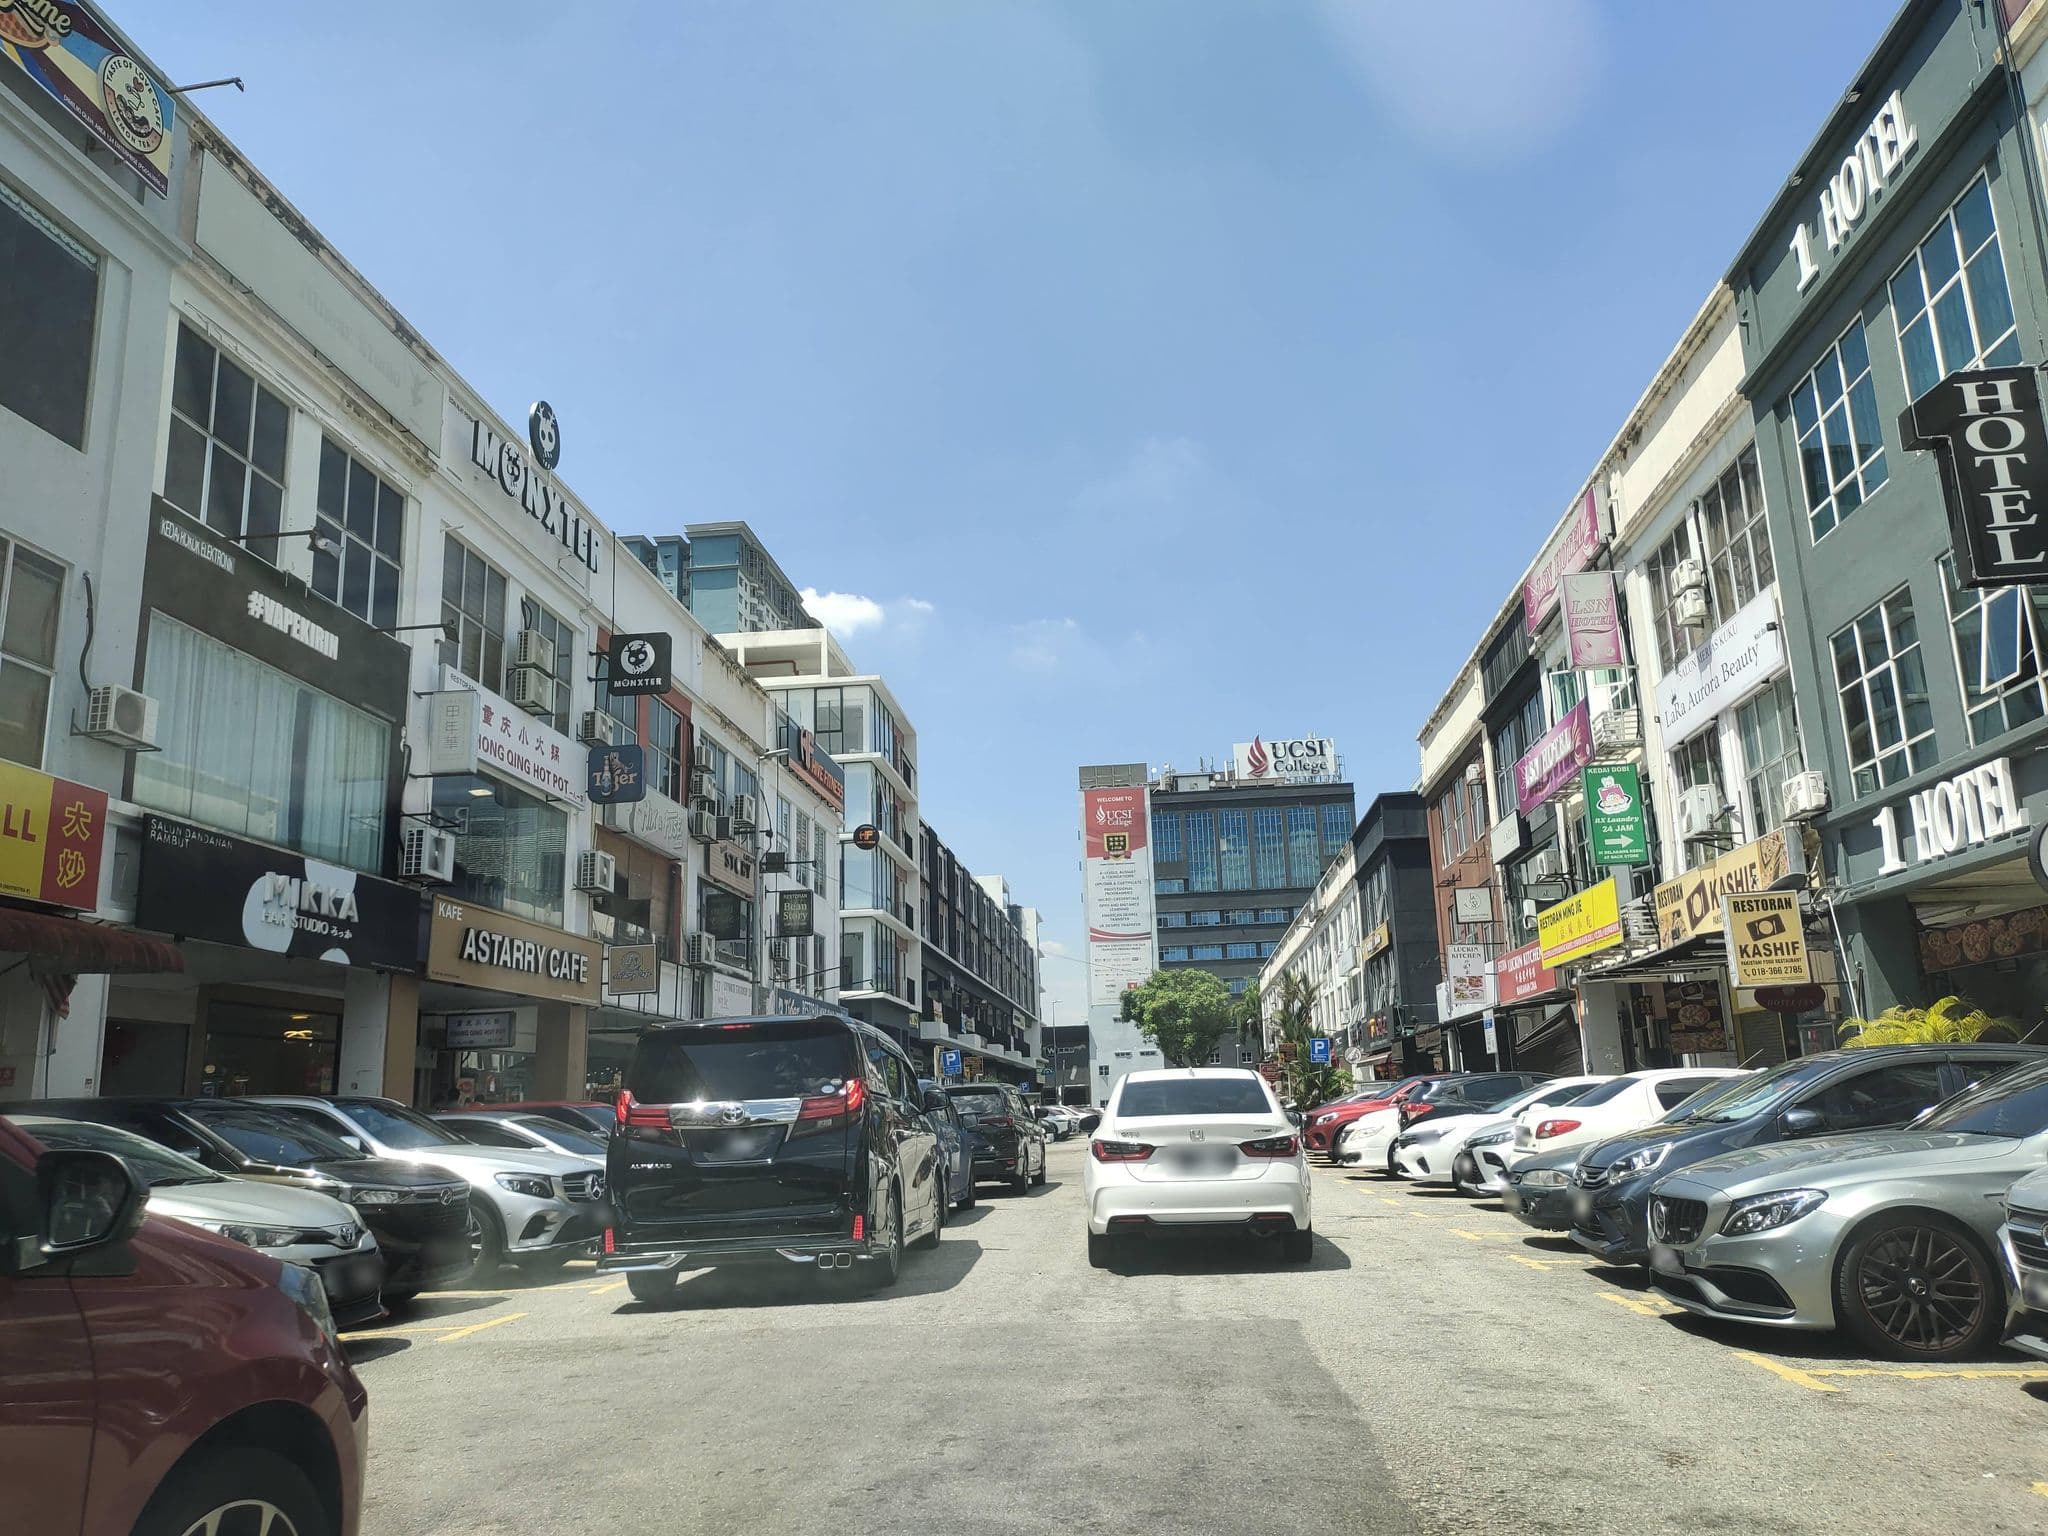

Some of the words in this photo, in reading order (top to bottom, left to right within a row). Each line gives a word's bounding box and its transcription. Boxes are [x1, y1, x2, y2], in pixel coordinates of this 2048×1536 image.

[106, 59, 124, 83] TASTE
[122, 59, 134, 70] OF
[133, 66, 155, 94] LOVE
[151, 97, 163, 130] CAFE
[112, 110, 136, 144] LEMON
[1789, 223, 1819, 292] 1
[1819, 89, 1919, 252] HOTEL
[1953, 379, 2046, 565] HOTEL
[472, 420, 603, 573] MONXTER
[1571, 598, 1613, 615] LSN
[1570, 615, 1614, 628] HOTEL
[613, 677, 663, 688] MONXTER
[1664, 700, 1687, 729] LaRa
[1688, 673, 1720, 711] Aurora
[1721, 643, 1761, 683] Beauty
[1270, 739, 1326, 759] UCSI
[506, 749, 531, 775] QING
[533, 764, 551, 786] HOT
[552, 774, 569, 795] POT
[1273, 760, 1328, 775] College
[1106, 809, 1133, 819] UCSI
[1607, 815, 1640, 824] Laundry
[1872, 806, 1908, 875] 1
[1909, 757, 2030, 862] HOTEL
[1602, 825, 1613, 833] 24
[1615, 824, 1634, 832] JAM
[56, 801, 92, 888] 大炒
[1657, 882, 1684, 909] RESTORAN
[1709, 861, 1757, 911] KASHIF
[263, 871, 359, 923] MIKKA
[784, 902, 808, 911] Bean
[1733, 897, 1793, 913] RESTORAN
[438, 902, 463, 922] KAFE
[783, 911, 809, 921] Story
[1540, 911, 1562, 930] RESTORAN
[1563, 903, 1575, 920] MING
[290, 915, 329, 936] STUDIO
[462, 928, 547, 974] ASTARRY
[549, 948, 590, 983] CAFE
[1739, 941, 1800, 959] KASHIF
[1314, 1041, 1325, 1054] P
[946, 1053, 957, 1066] P
